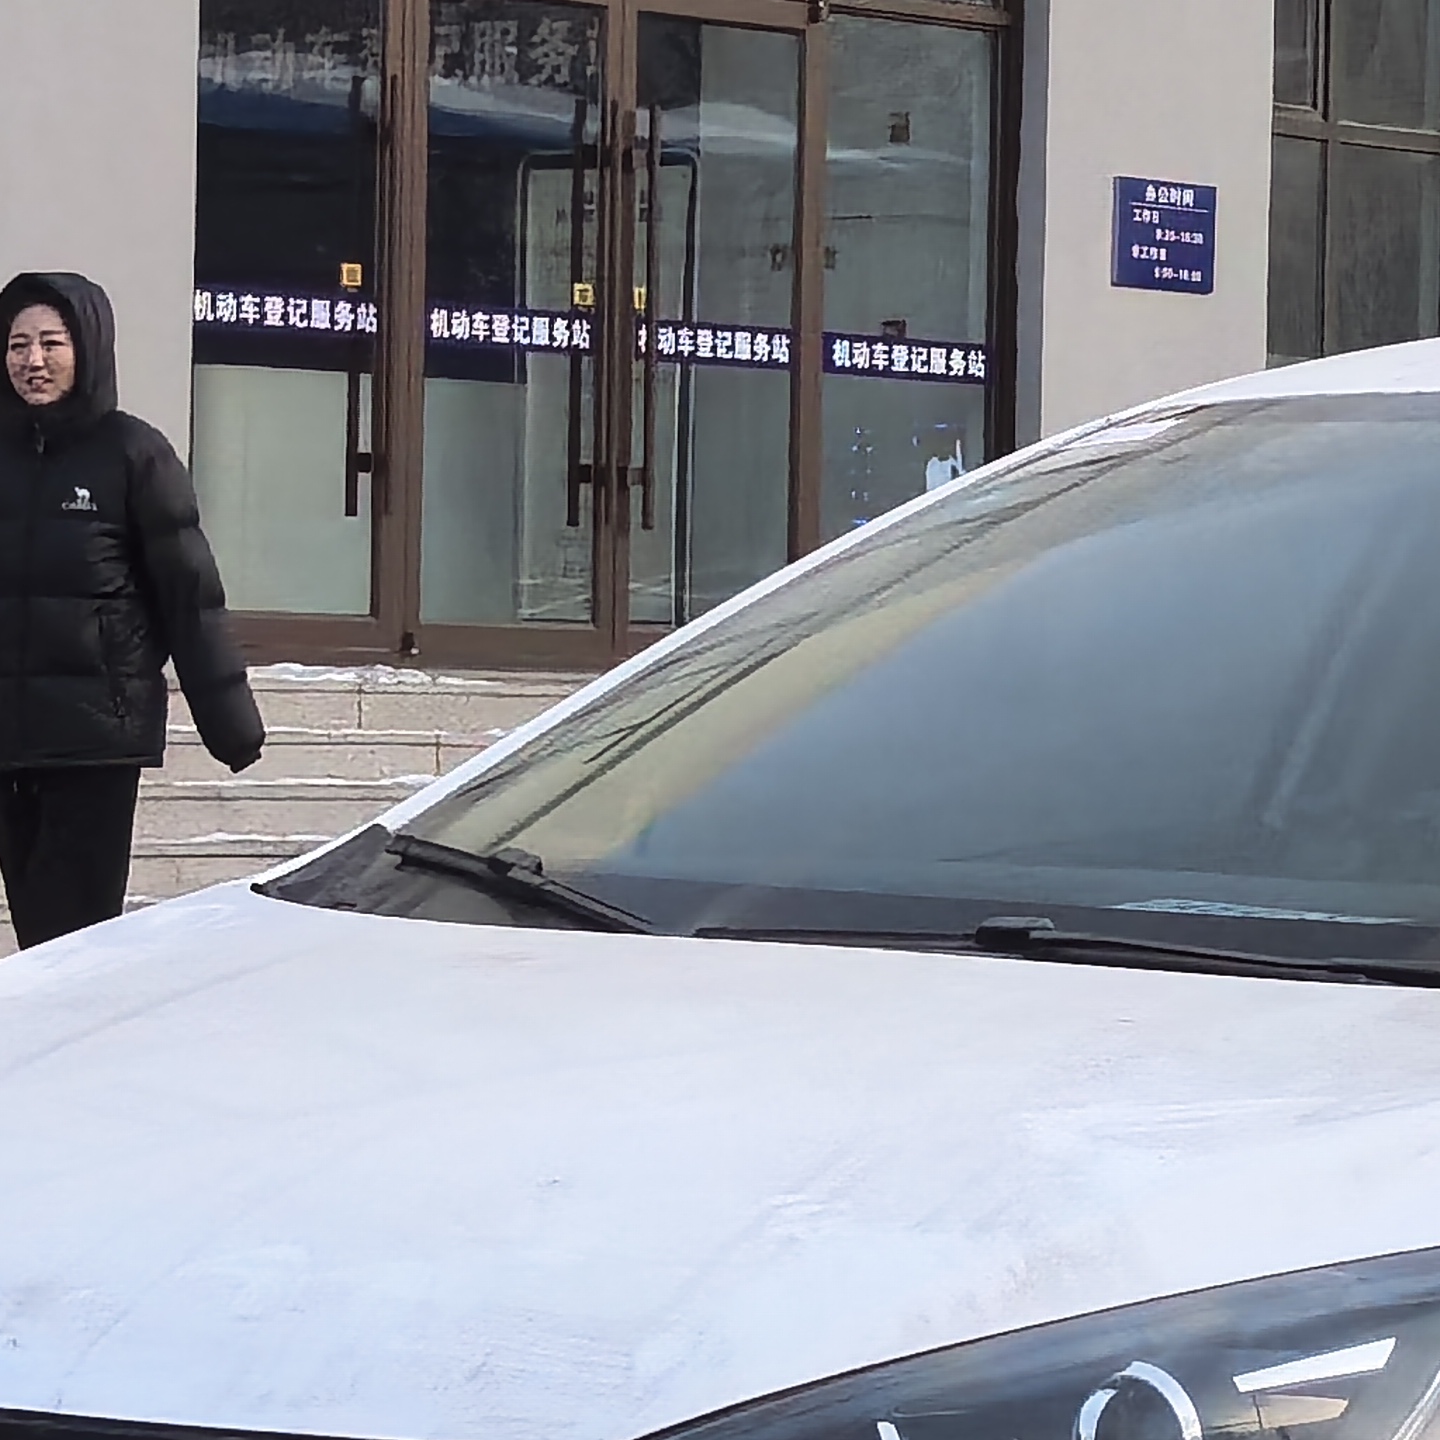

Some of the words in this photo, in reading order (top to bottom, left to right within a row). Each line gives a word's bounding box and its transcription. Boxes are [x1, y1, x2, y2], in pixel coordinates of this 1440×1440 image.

[193, 289, 378, 333] 机动车登记服务站
[430, 308, 592, 350] 机动车登记服务站
[831, 339, 986, 379] 机动车登记服务站
